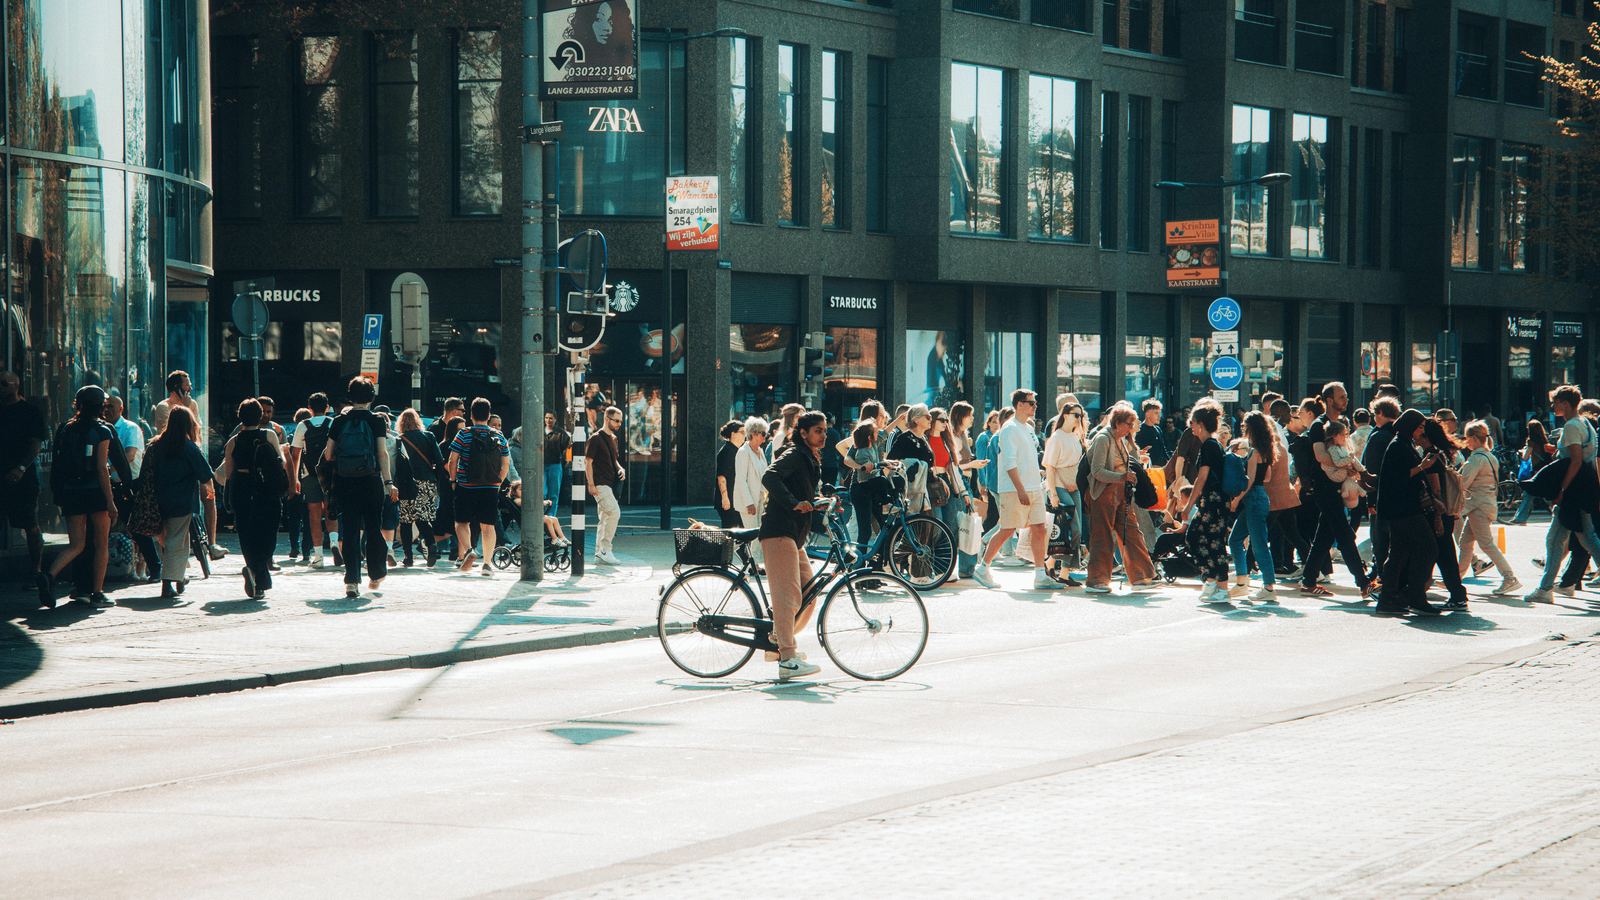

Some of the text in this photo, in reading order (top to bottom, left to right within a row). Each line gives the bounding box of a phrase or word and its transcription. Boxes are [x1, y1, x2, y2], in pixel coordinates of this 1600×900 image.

[568, 66, 633, 77] 0302231500
[547, 85, 634, 95] LANGE JANSSTRAAT 63
[588, 106, 645, 133] ZARA
[668, 205, 717, 216] Smaragdplein
[674, 216, 691, 226] 254
[668, 230, 696, 241] Wij zijn
[680, 234, 718, 247] verhuisd!!
[1168, 279, 1213, 287] KAATSTRAAT
[830, 295, 877, 309] STARBUCKS
[367, 317, 378, 334] P
[1554, 325, 1581, 334] THE STING
[364, 338, 379, 346] taxi
